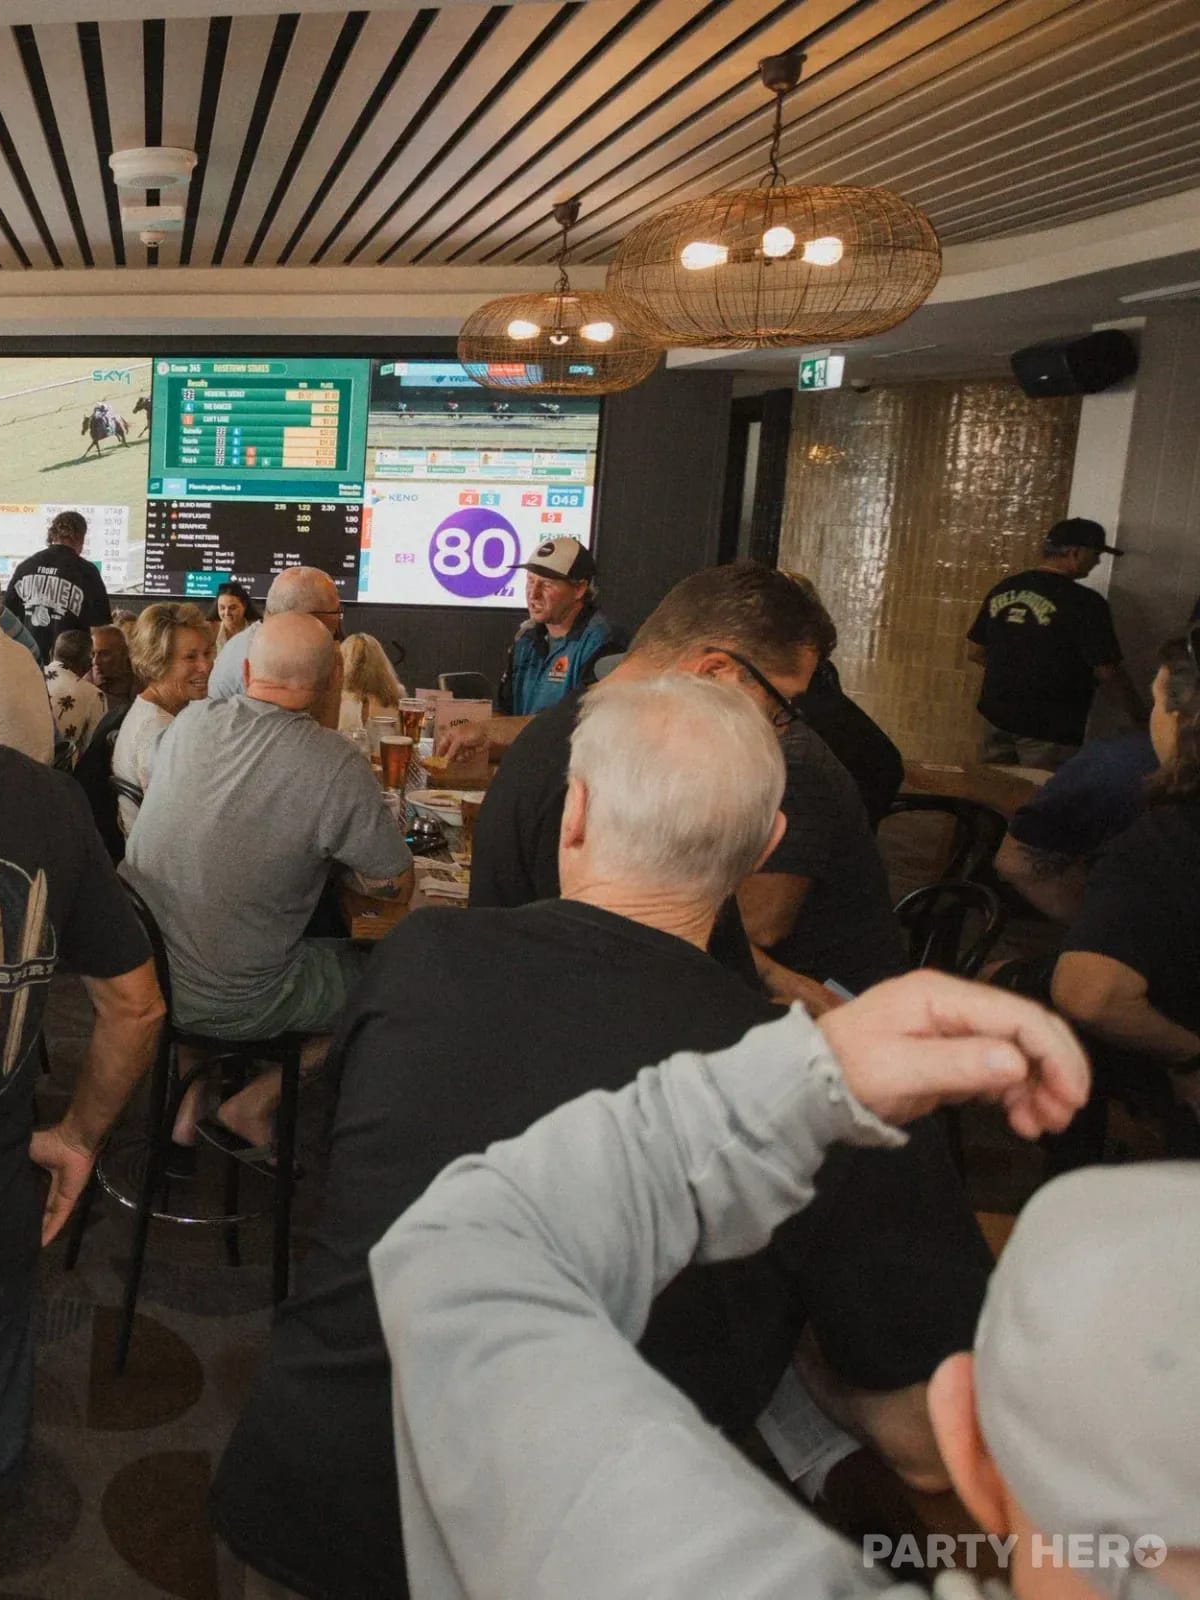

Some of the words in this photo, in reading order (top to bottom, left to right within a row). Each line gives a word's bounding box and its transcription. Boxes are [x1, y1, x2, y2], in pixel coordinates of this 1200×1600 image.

[389, 493, 419, 502] KENO
[464, 494, 473, 504] 4
[485, 494, 494, 504] 3
[551, 495, 578, 506] 048
[433, 527, 517, 578] 80
[37, 566, 58, 576] FRONT
